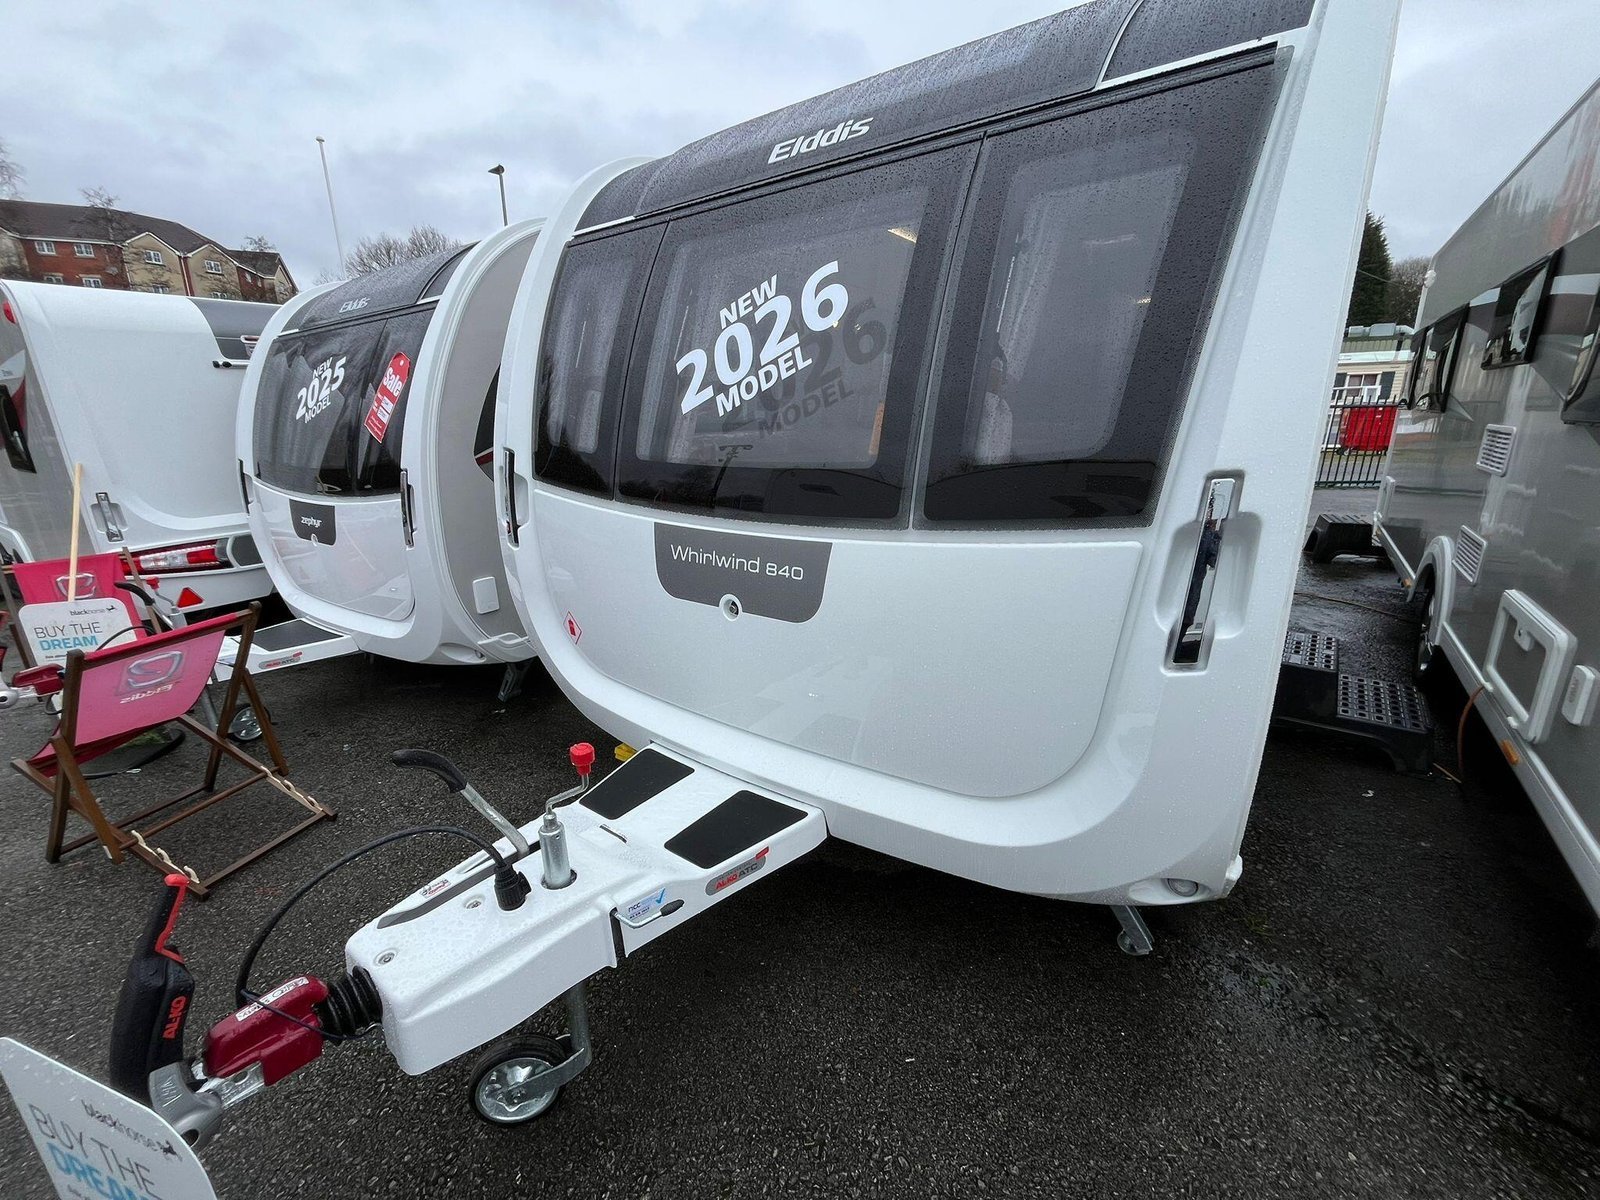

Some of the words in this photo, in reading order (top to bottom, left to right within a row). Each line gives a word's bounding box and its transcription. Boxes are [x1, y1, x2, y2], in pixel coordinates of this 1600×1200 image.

[767, 117, 874, 164] Elddis
[719, 274, 778, 329] NEW
[675, 260, 849, 415] 2026
[312, 357, 333, 379] NEW
[383, 367, 403, 397] Sale
[715, 346, 813, 417] MODEL
[296, 356, 347, 420] 2025
[304, 396, 332, 424] MODEL
[670, 544, 760, 574] Whirlwind
[765, 562, 804, 581] 840
[34, 624, 66, 639] BUY
[69, 621, 103, 635] THE
[39, 635, 99, 651] DREAM
[738, 862, 758, 878] ATC
[28, 1103, 89, 1159] BUY
[90, 1137, 162, 1200] THE
